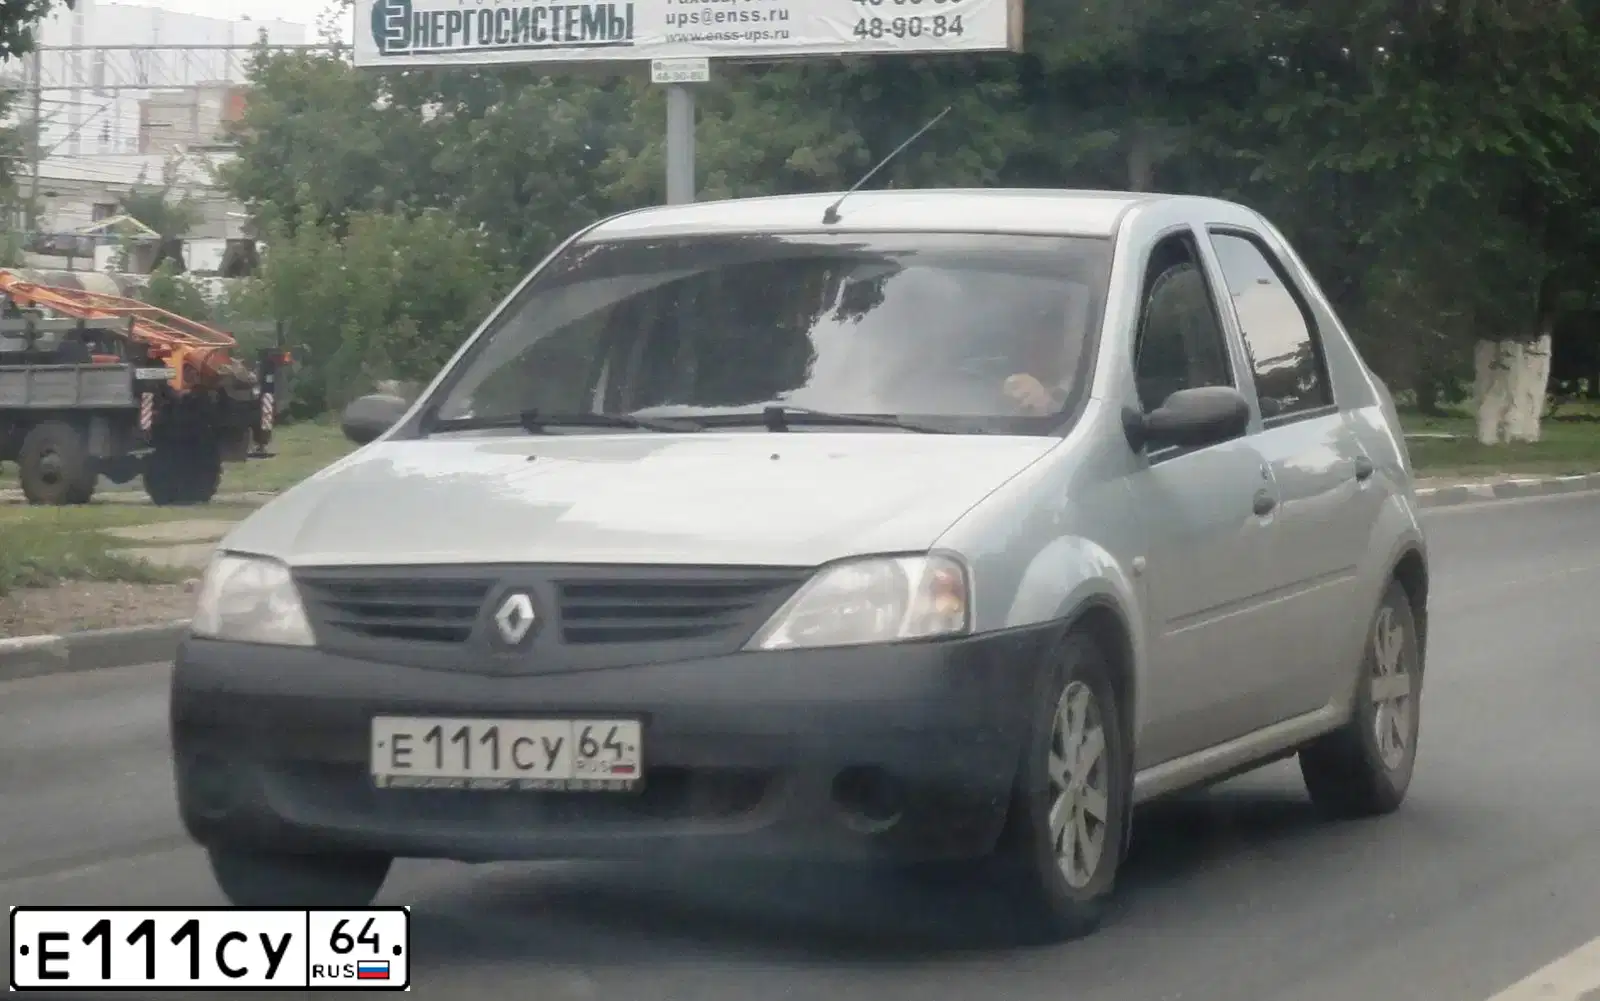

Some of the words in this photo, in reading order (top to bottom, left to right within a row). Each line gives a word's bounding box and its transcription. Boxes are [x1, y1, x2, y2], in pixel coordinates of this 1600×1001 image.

[665, 8, 789, 28] ups@enss.ru
[853, 15, 964, 39] 48-90-84
[665, 29, 789, 43] www.enss-ups.ru
[579, 726, 622, 759] 64
